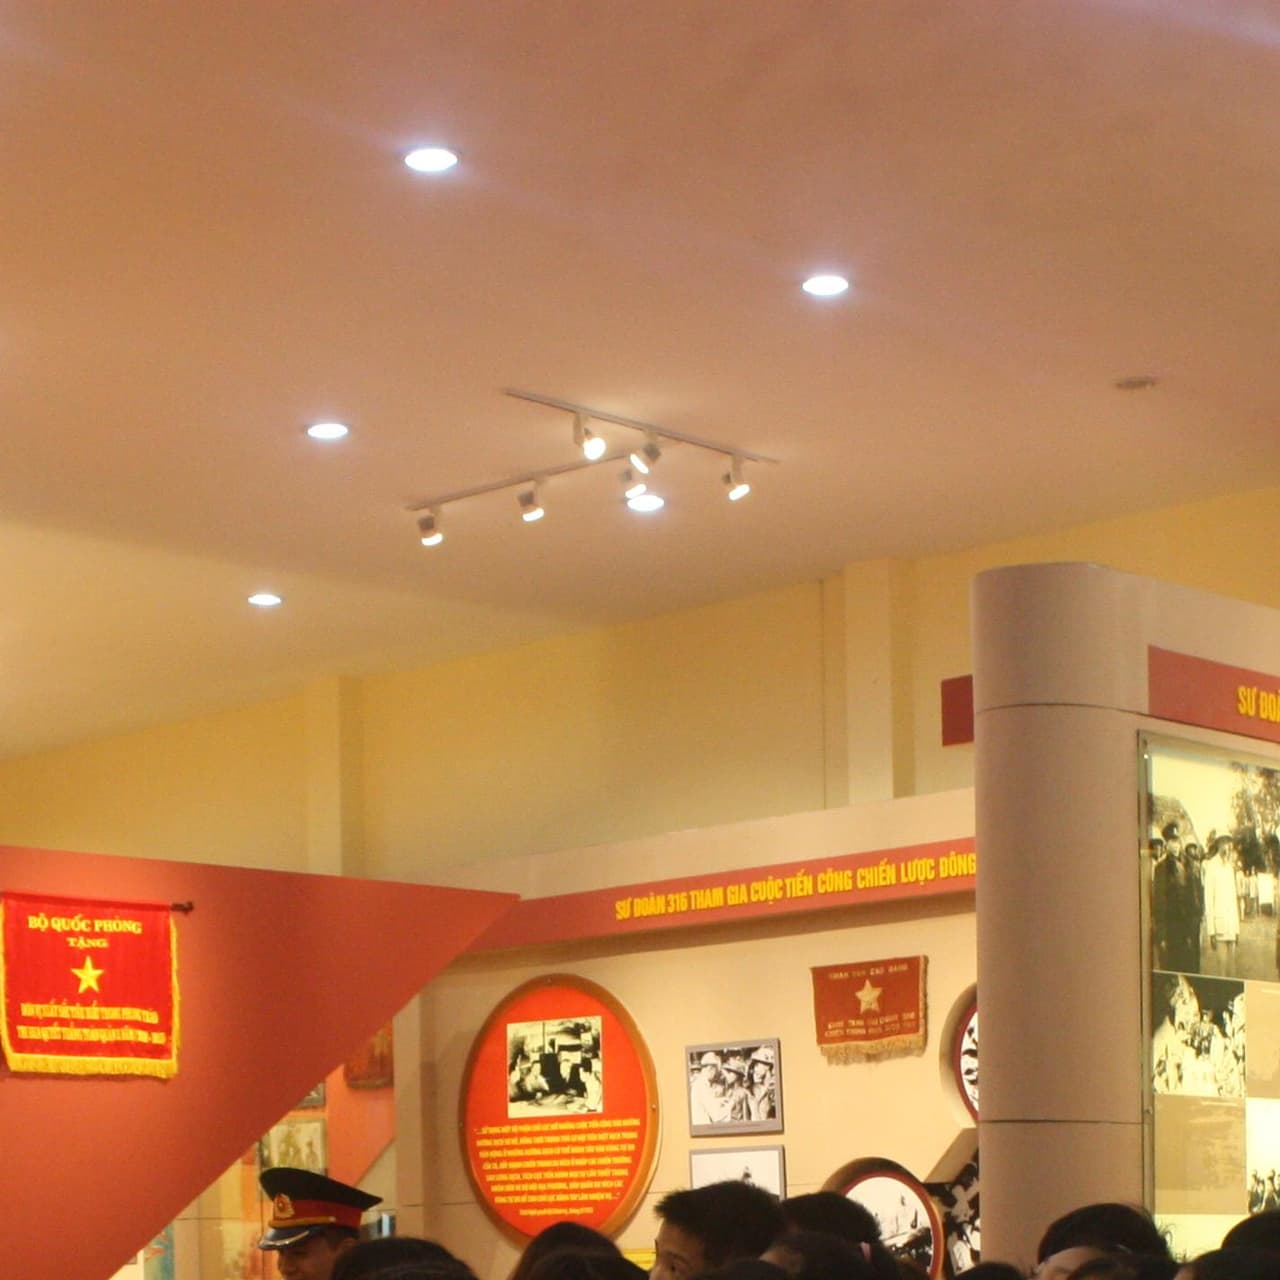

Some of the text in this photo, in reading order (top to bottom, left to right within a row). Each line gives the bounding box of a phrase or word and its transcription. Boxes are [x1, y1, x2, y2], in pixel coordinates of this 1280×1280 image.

[1237, 686, 1256, 717] SƯ
[615, 851, 976, 920] SƯ ĐOÀN 316 THAM GIA CUỘC TIẾN CÔNG CHIẾN LƯỢC ĐÔNG
[28, 912, 142, 934] BỘ QUỐC PHÒNG
[66, 936, 109, 950] TẶNG
